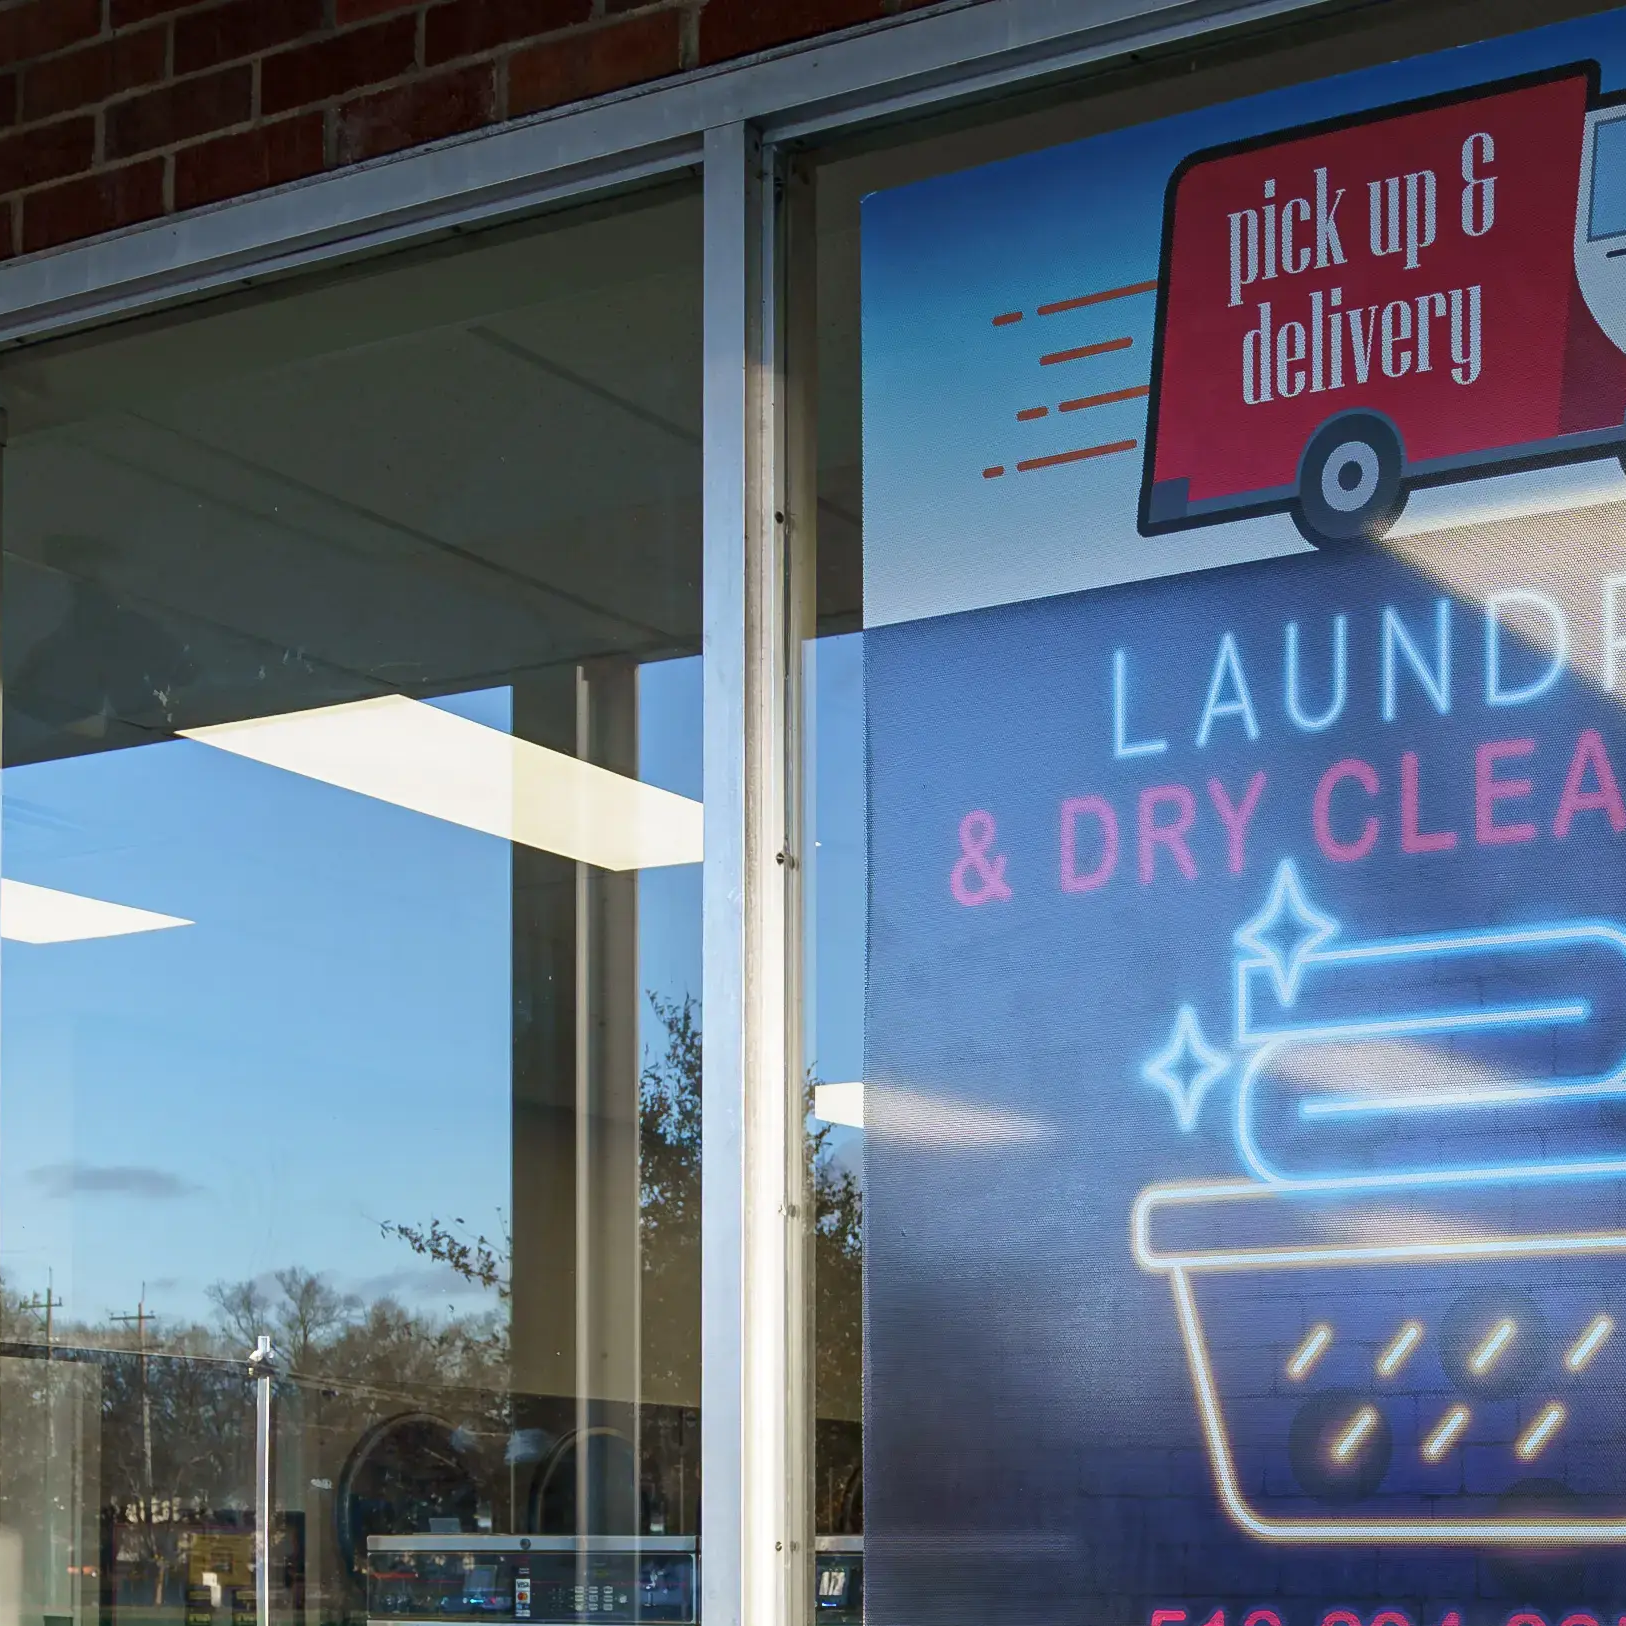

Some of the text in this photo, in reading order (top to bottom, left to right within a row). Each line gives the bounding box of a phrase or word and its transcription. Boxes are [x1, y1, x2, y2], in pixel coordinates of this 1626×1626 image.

[1227, 132, 1499, 307] pick up &
[1242, 285, 1482, 405] delivery
[948, 808, 1014, 908] &
[1059, 771, 1268, 894] DRY
